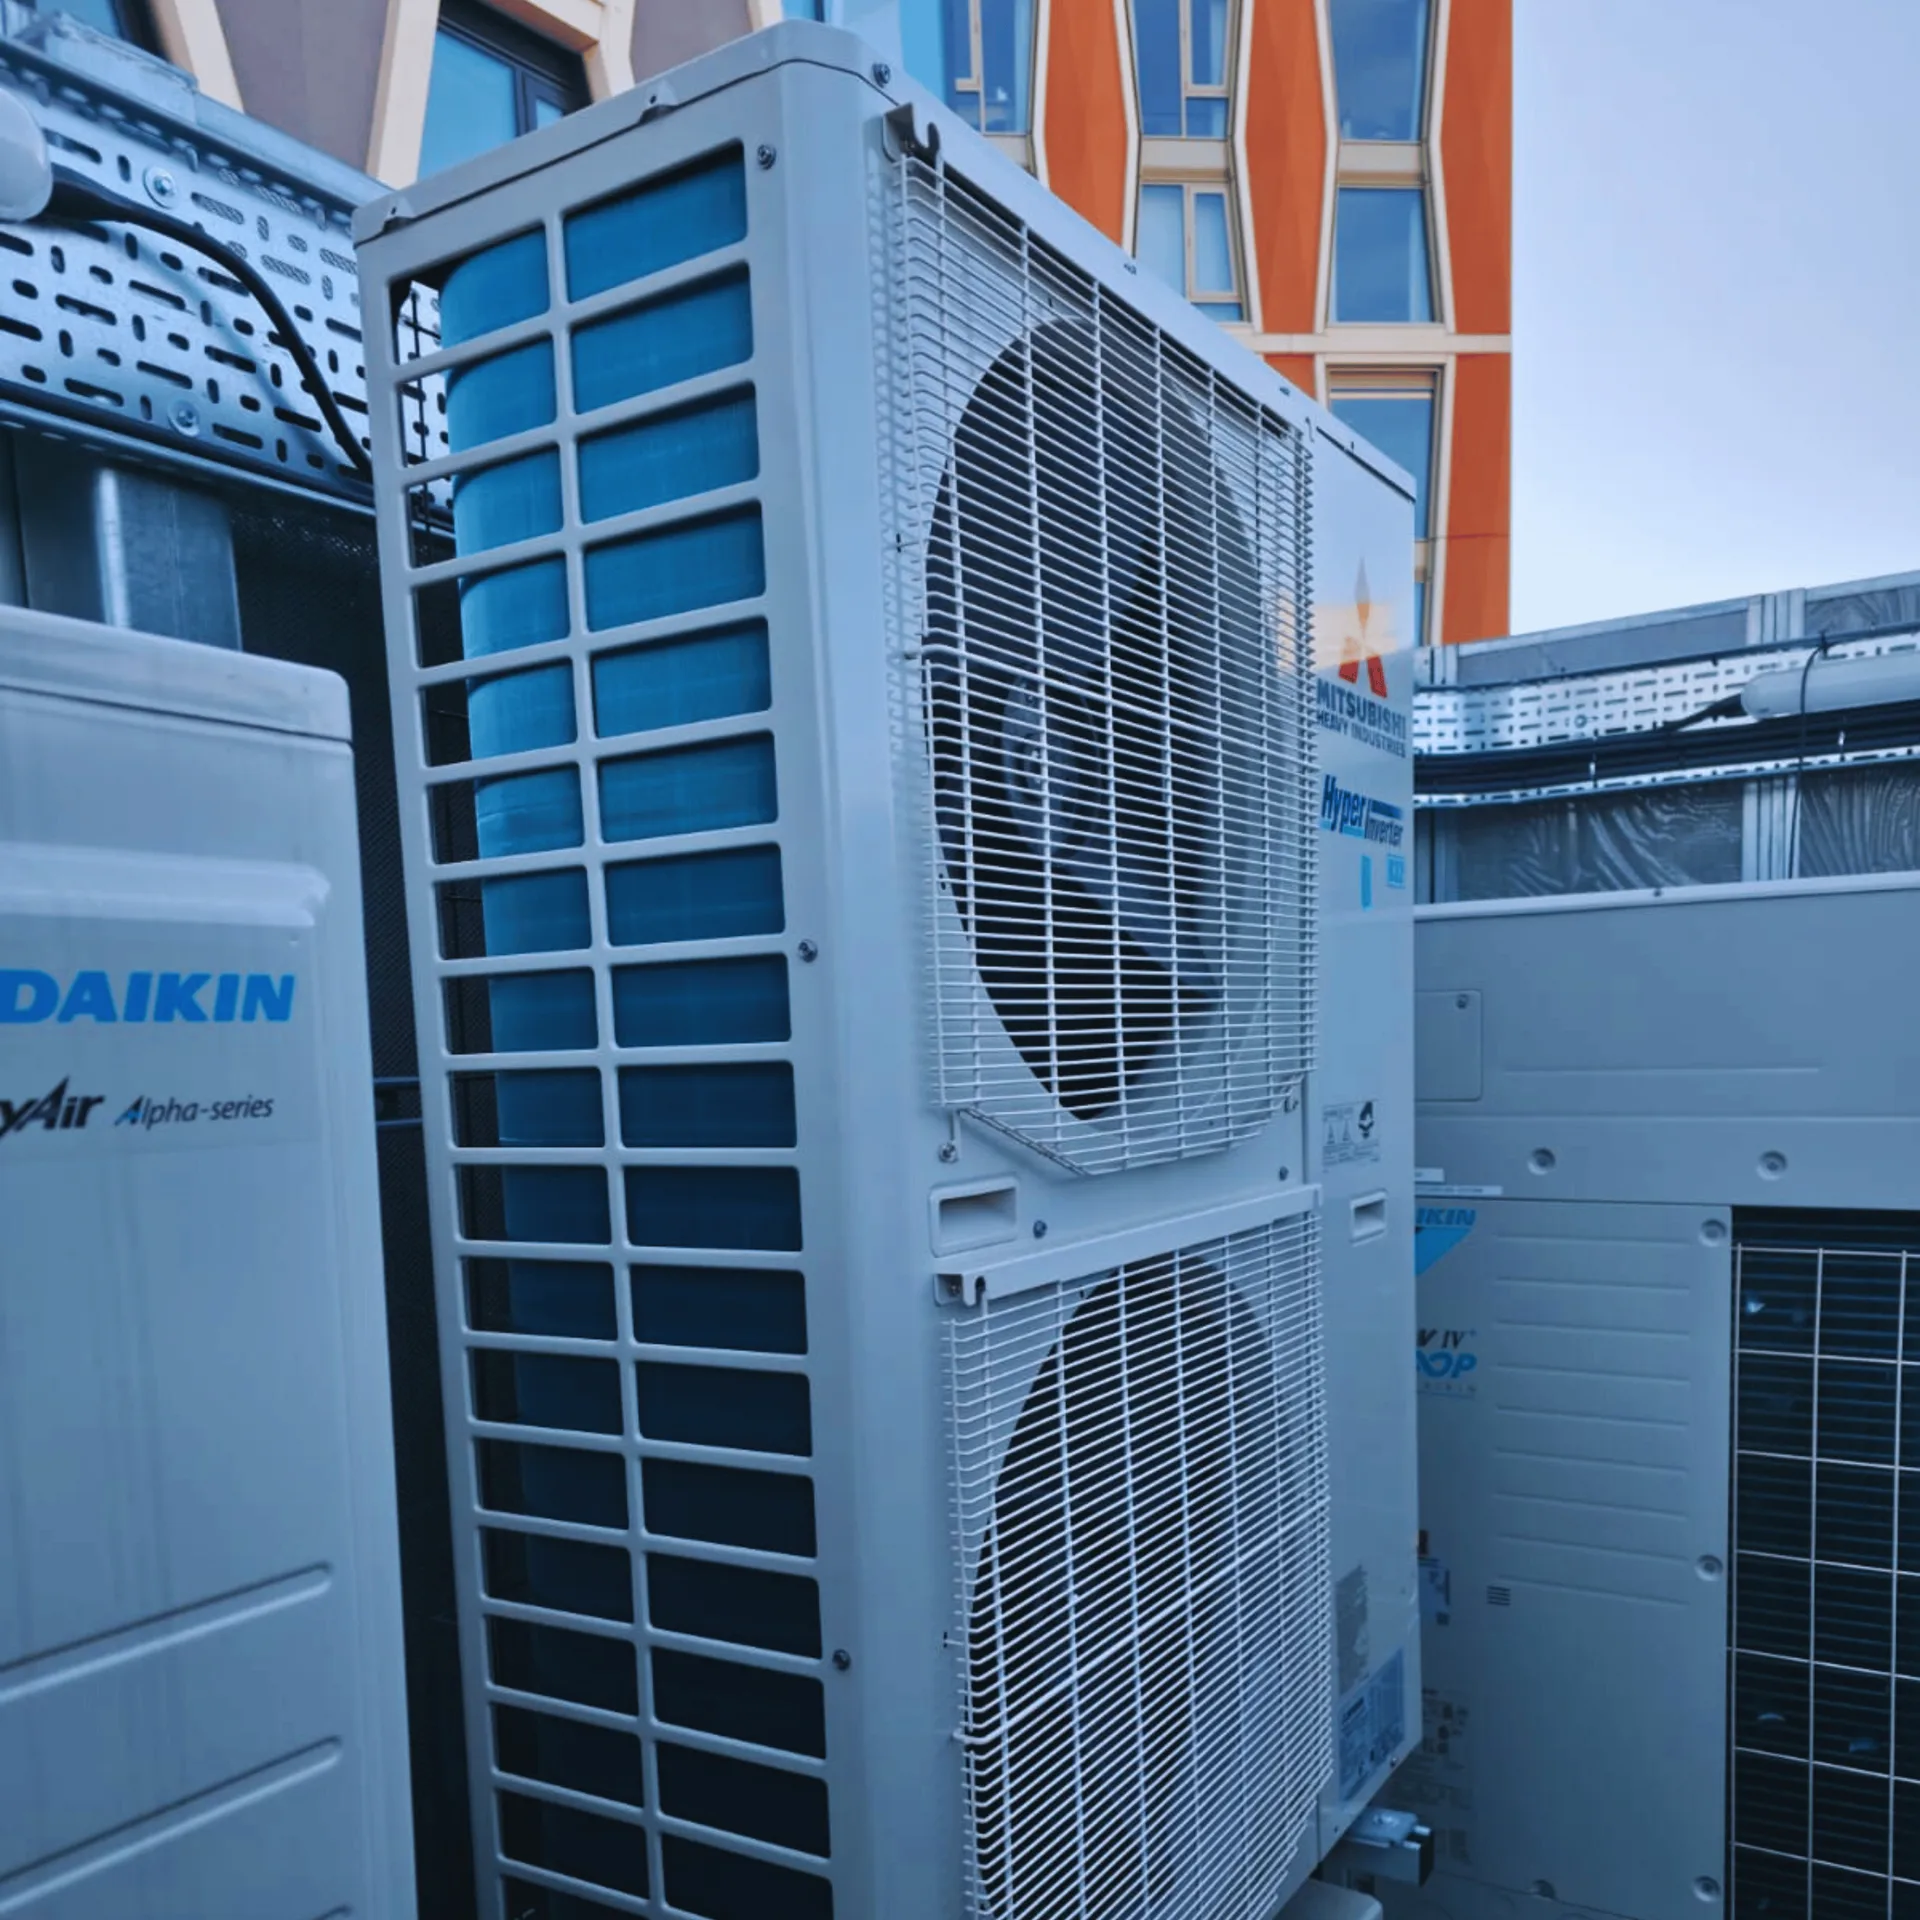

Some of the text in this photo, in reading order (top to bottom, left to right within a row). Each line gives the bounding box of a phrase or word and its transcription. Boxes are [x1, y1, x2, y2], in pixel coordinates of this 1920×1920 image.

[1316, 677, 1406, 741] MITSUBISHI
[1316, 710, 1406, 759] HEAVY INDUSTRIES
[1321, 774, 1404, 847] Hyper Inverter
[0, 968, 295, 1024] DAIKIN
[113, 1095, 275, 1131] Alpha-series
